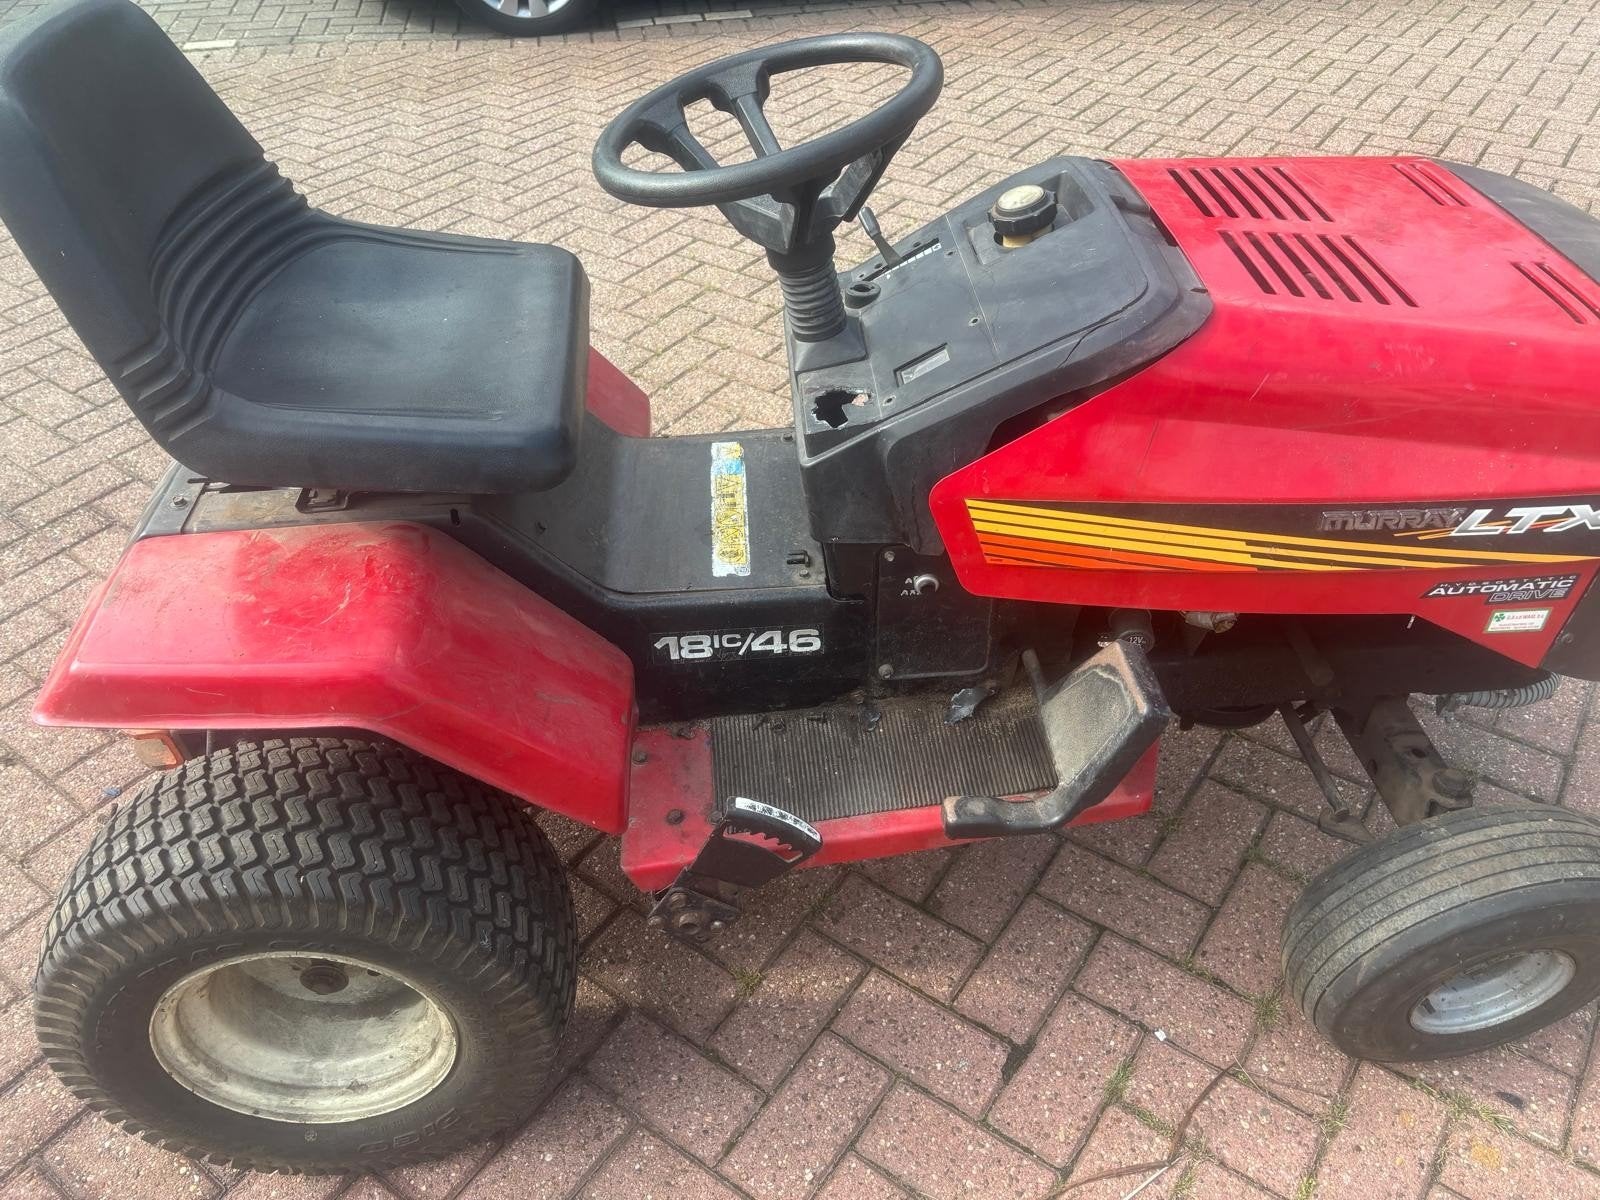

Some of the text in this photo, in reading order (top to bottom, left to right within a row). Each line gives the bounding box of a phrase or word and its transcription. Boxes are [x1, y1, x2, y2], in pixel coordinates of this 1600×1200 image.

[1320, 504, 1600, 536] MURRAY LTX
[1428, 579, 1574, 596] AUTOMATIC
[1488, 588, 1568, 602] DRIVE
